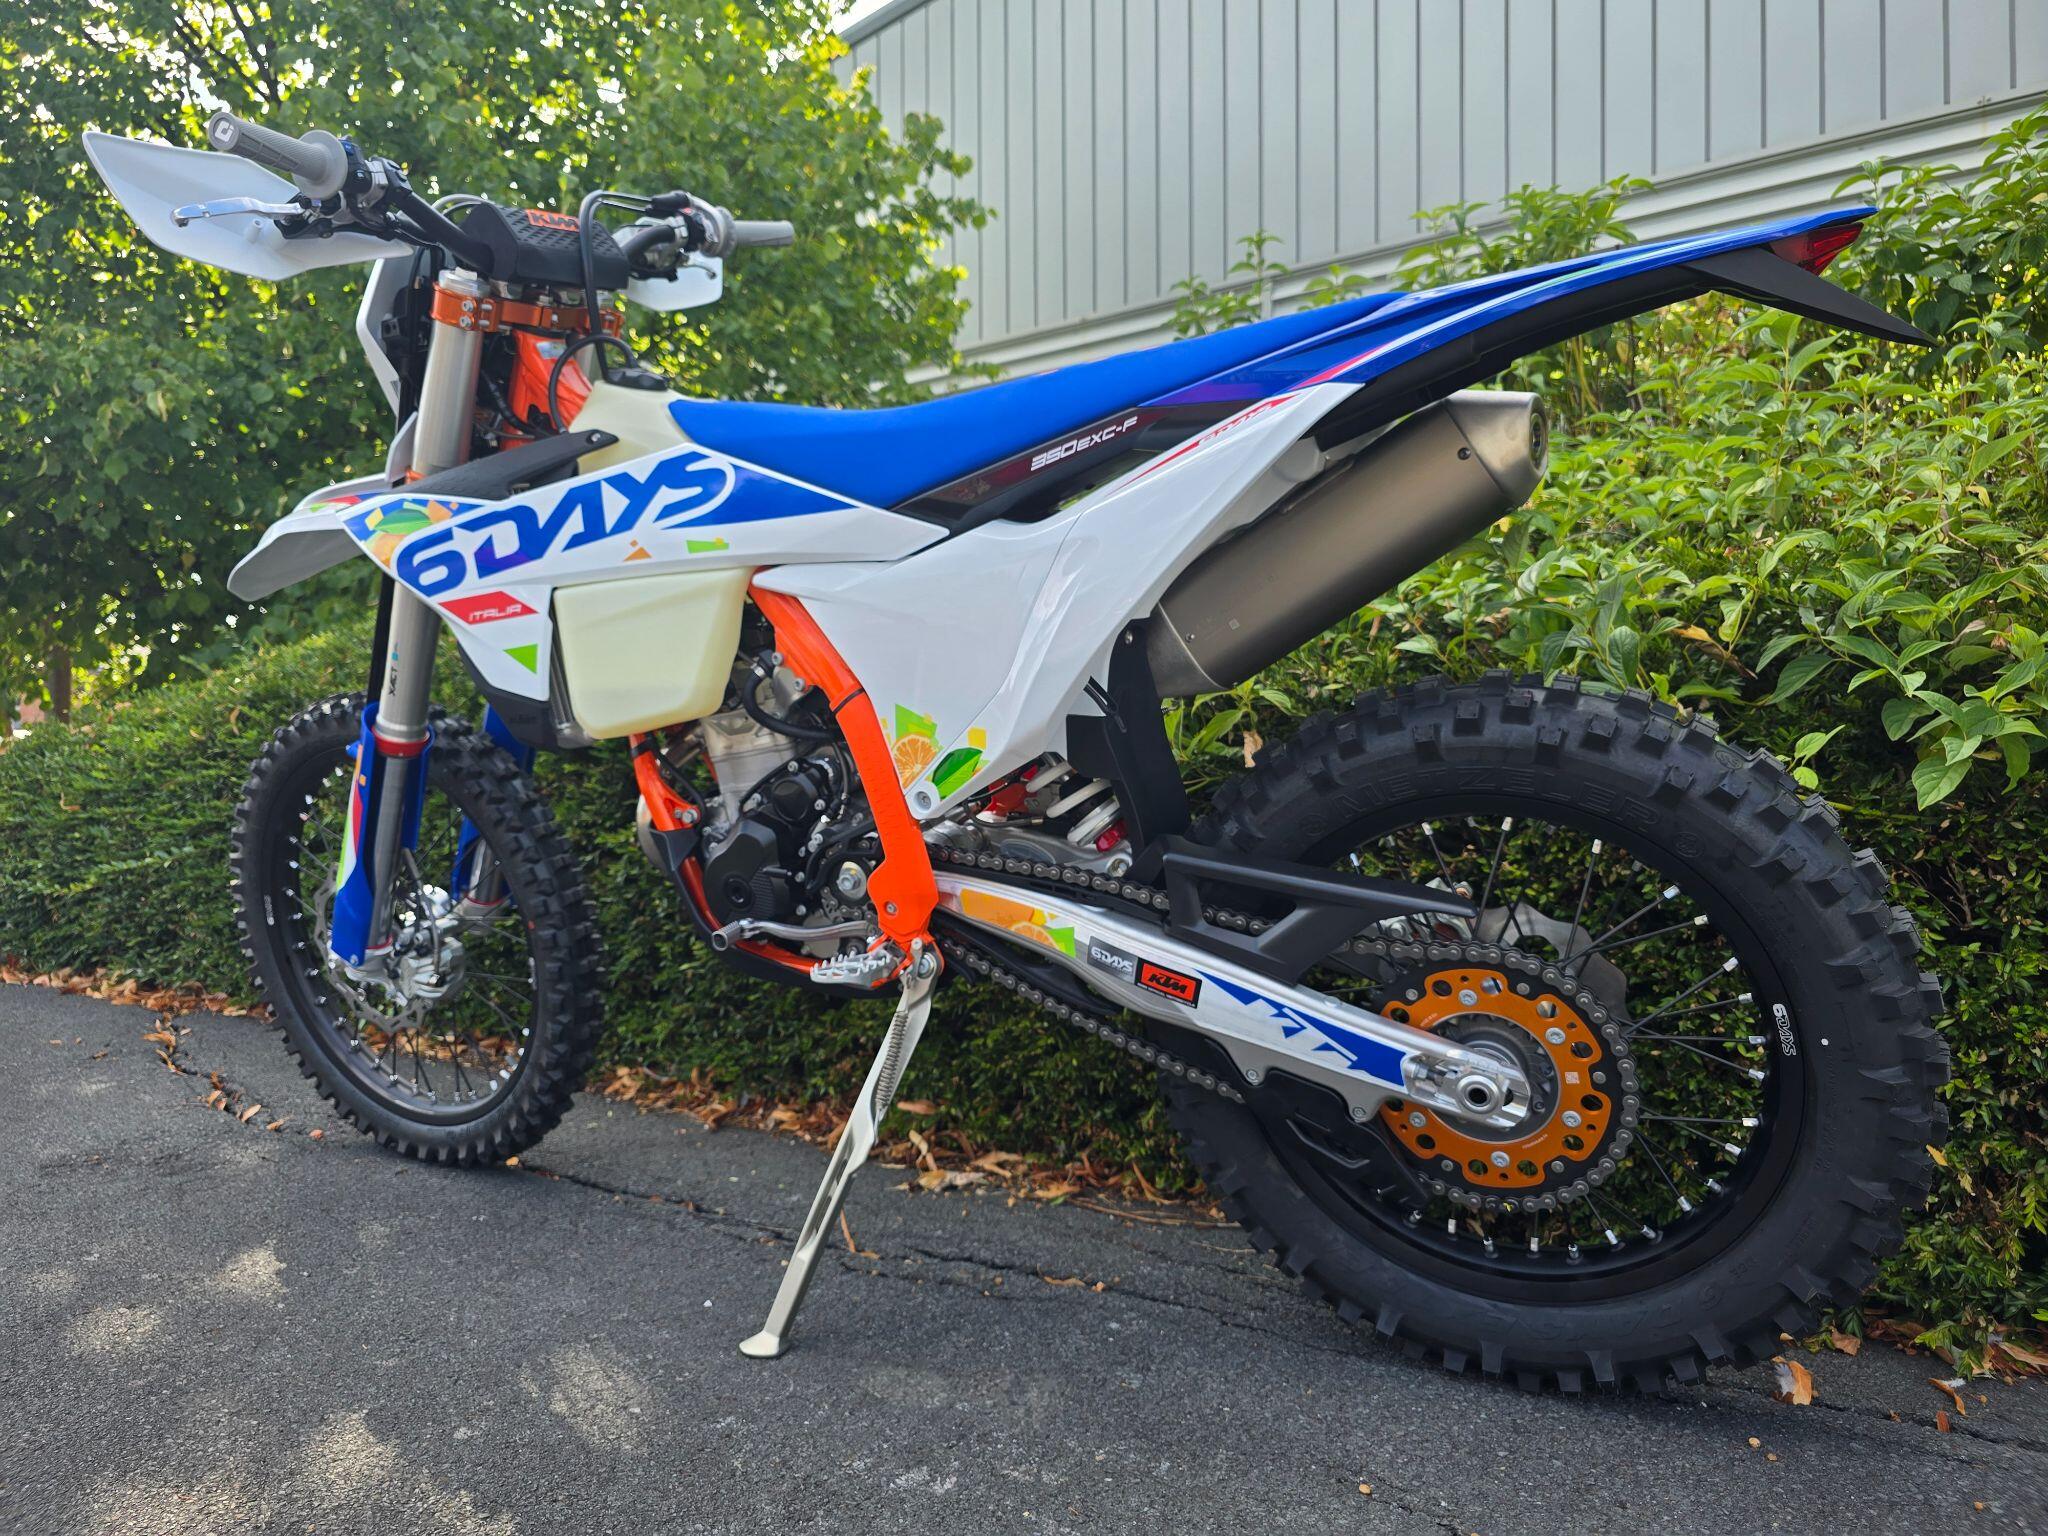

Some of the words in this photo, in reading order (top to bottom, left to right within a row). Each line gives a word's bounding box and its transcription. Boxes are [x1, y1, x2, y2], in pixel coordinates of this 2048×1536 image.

[397, 450, 726, 597] 6DAYS
[468, 604, 522, 622] ITALIA
[1333, 766, 1660, 833] METZELER
[1091, 946, 1133, 973] 6DAYS
[1149, 973, 1188, 994] KTM
[1772, 1003, 1797, 1056] 6DAYS
